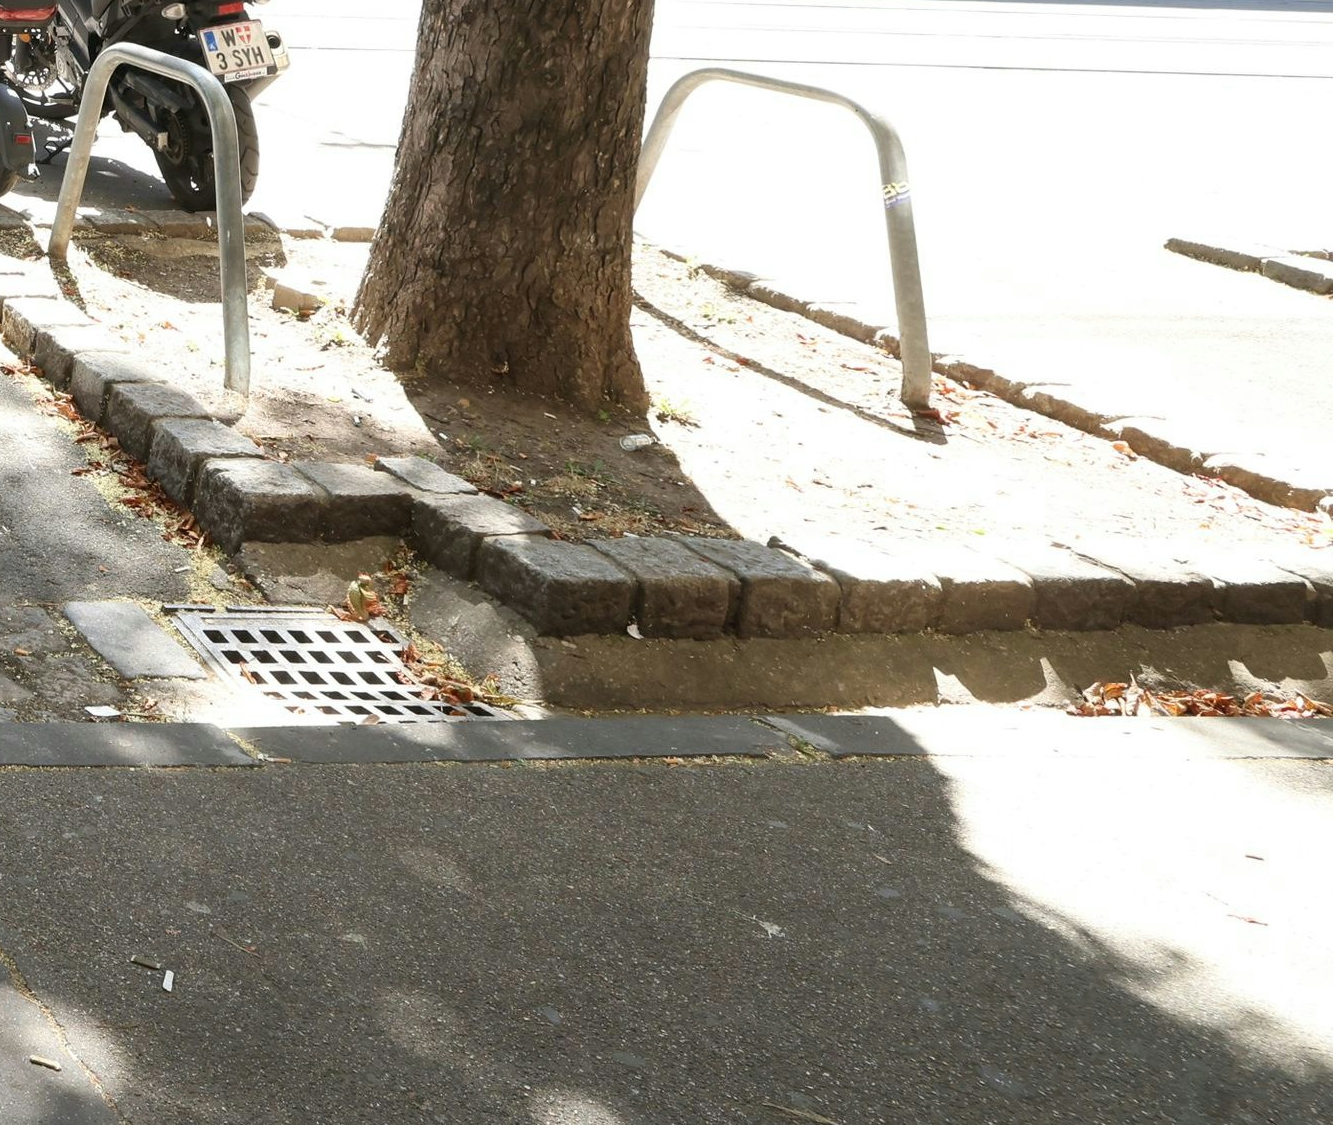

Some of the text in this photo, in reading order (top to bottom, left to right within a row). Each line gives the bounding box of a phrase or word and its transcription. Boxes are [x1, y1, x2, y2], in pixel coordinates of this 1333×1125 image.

[220, 28, 236, 48] W
[216, 45, 265, 70] 3 SYH
